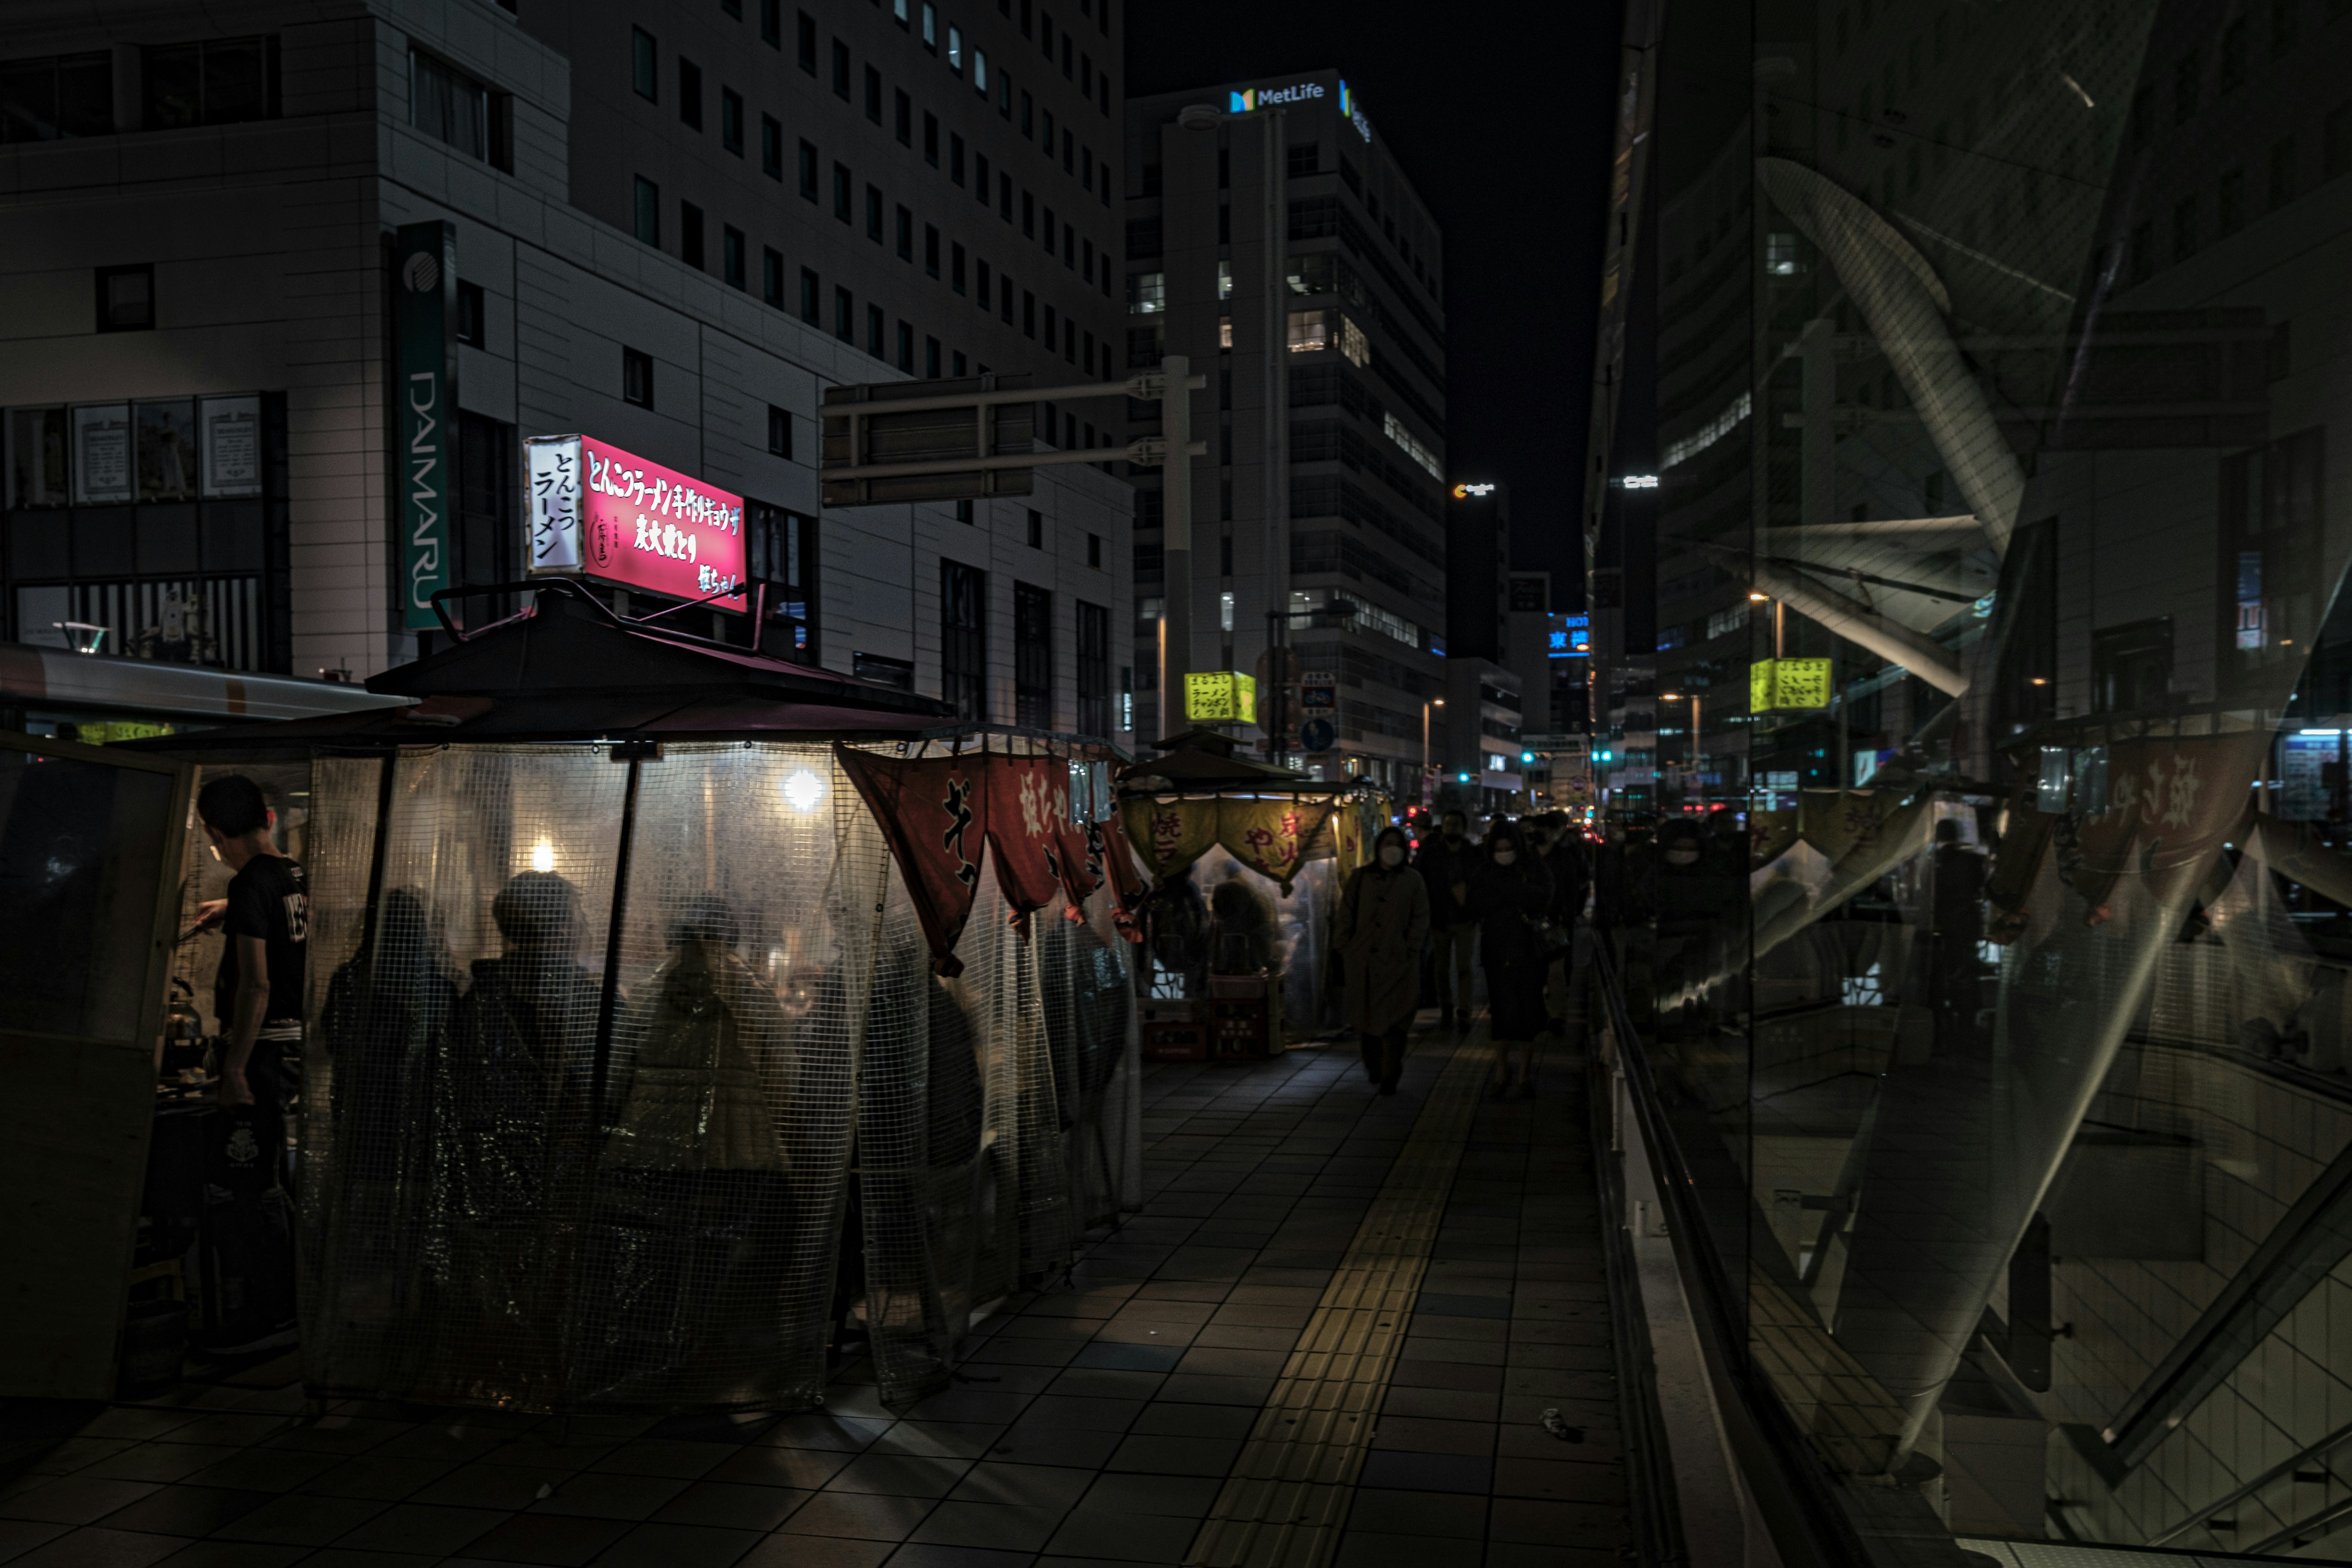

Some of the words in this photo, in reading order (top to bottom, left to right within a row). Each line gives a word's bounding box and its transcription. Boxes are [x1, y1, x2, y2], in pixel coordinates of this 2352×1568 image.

[1257, 83, 1325, 107] MetLife
[409, 371, 440, 609] DAIMARU
[534, 471, 558, 559] ラーメン
[555, 453, 575, 531] とんこつ
[1192, 688, 1229, 698] ラーメン
